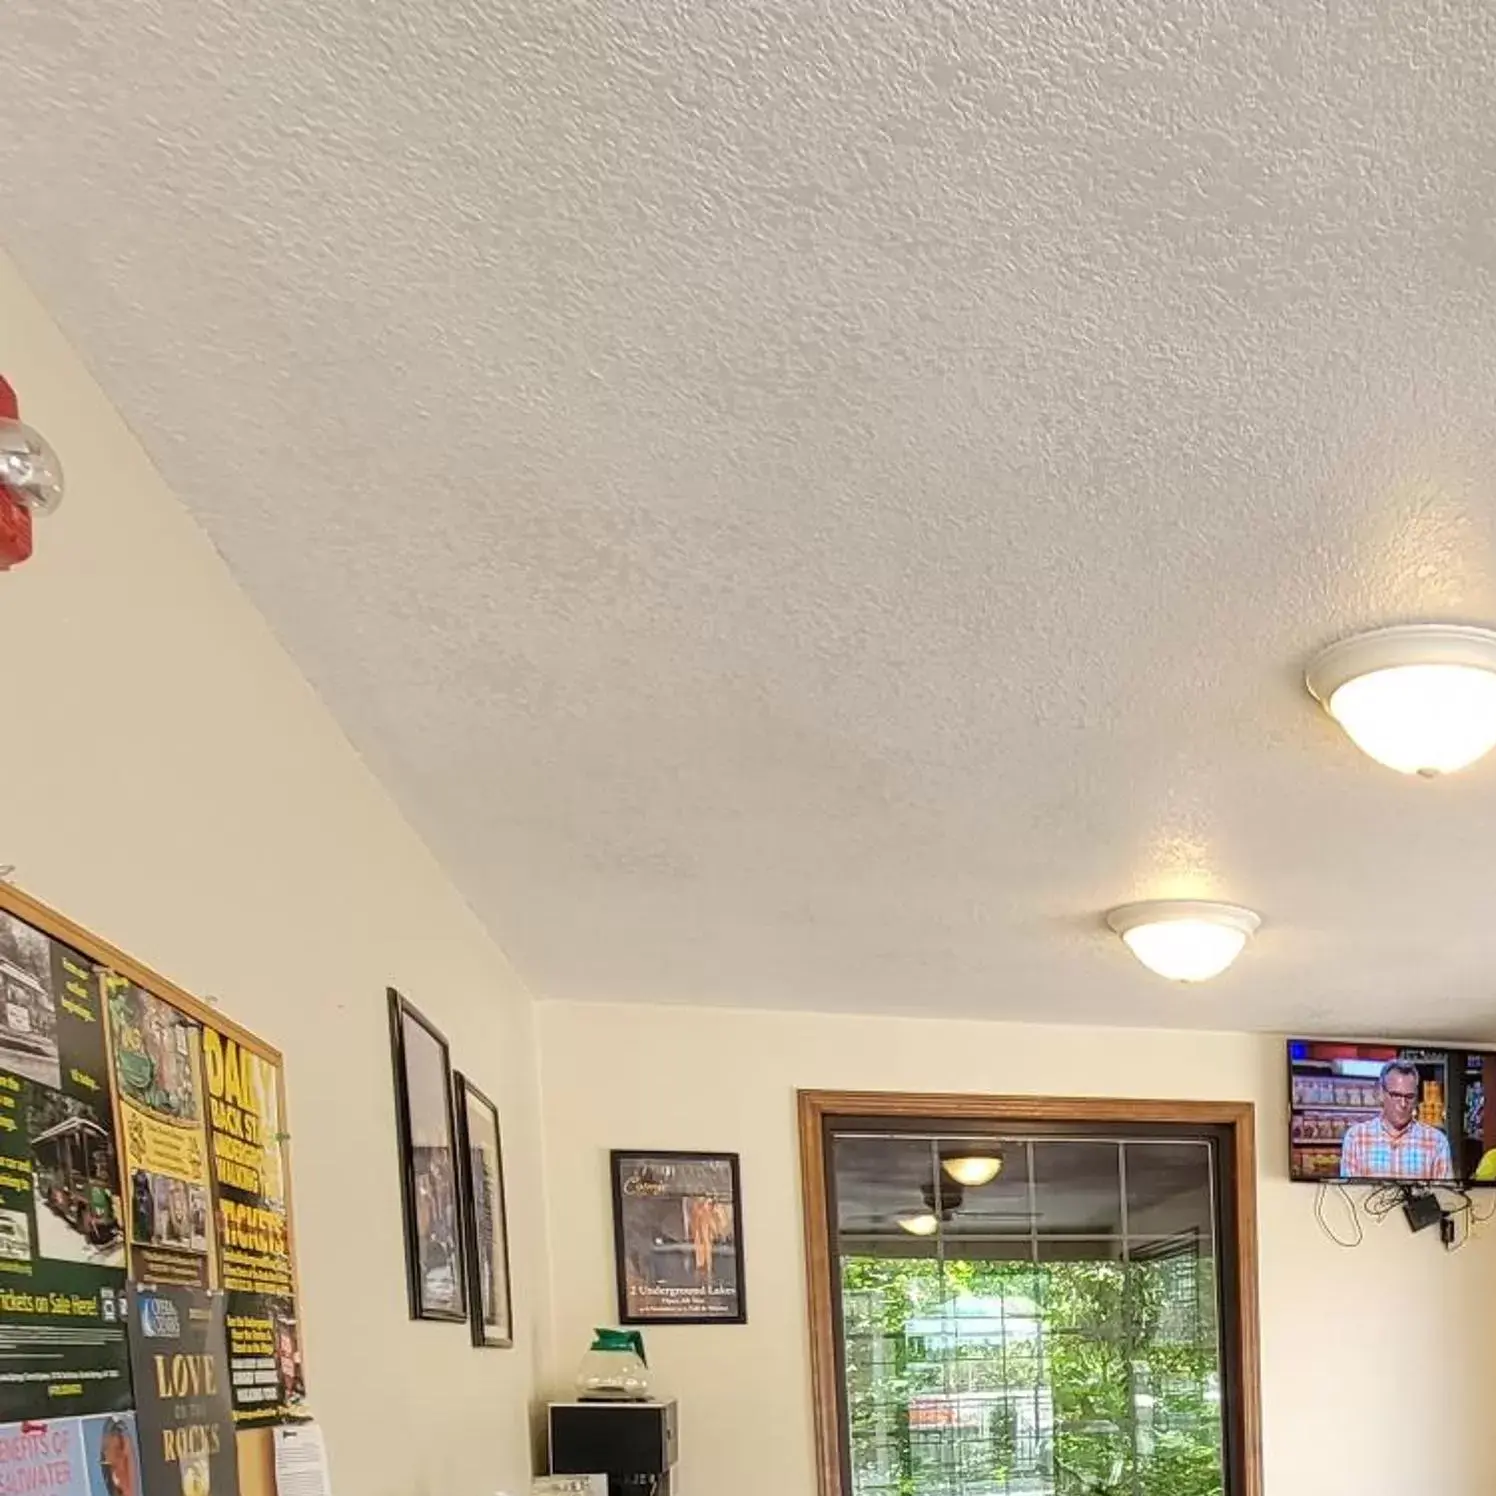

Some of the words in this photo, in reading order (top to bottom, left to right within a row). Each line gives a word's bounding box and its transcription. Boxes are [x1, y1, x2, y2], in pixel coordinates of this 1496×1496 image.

[638, 1285, 706, 1297] Underground
[153, 1354, 218, 1398] LOVE
[162, 1423, 221, 1463] ROCKS
